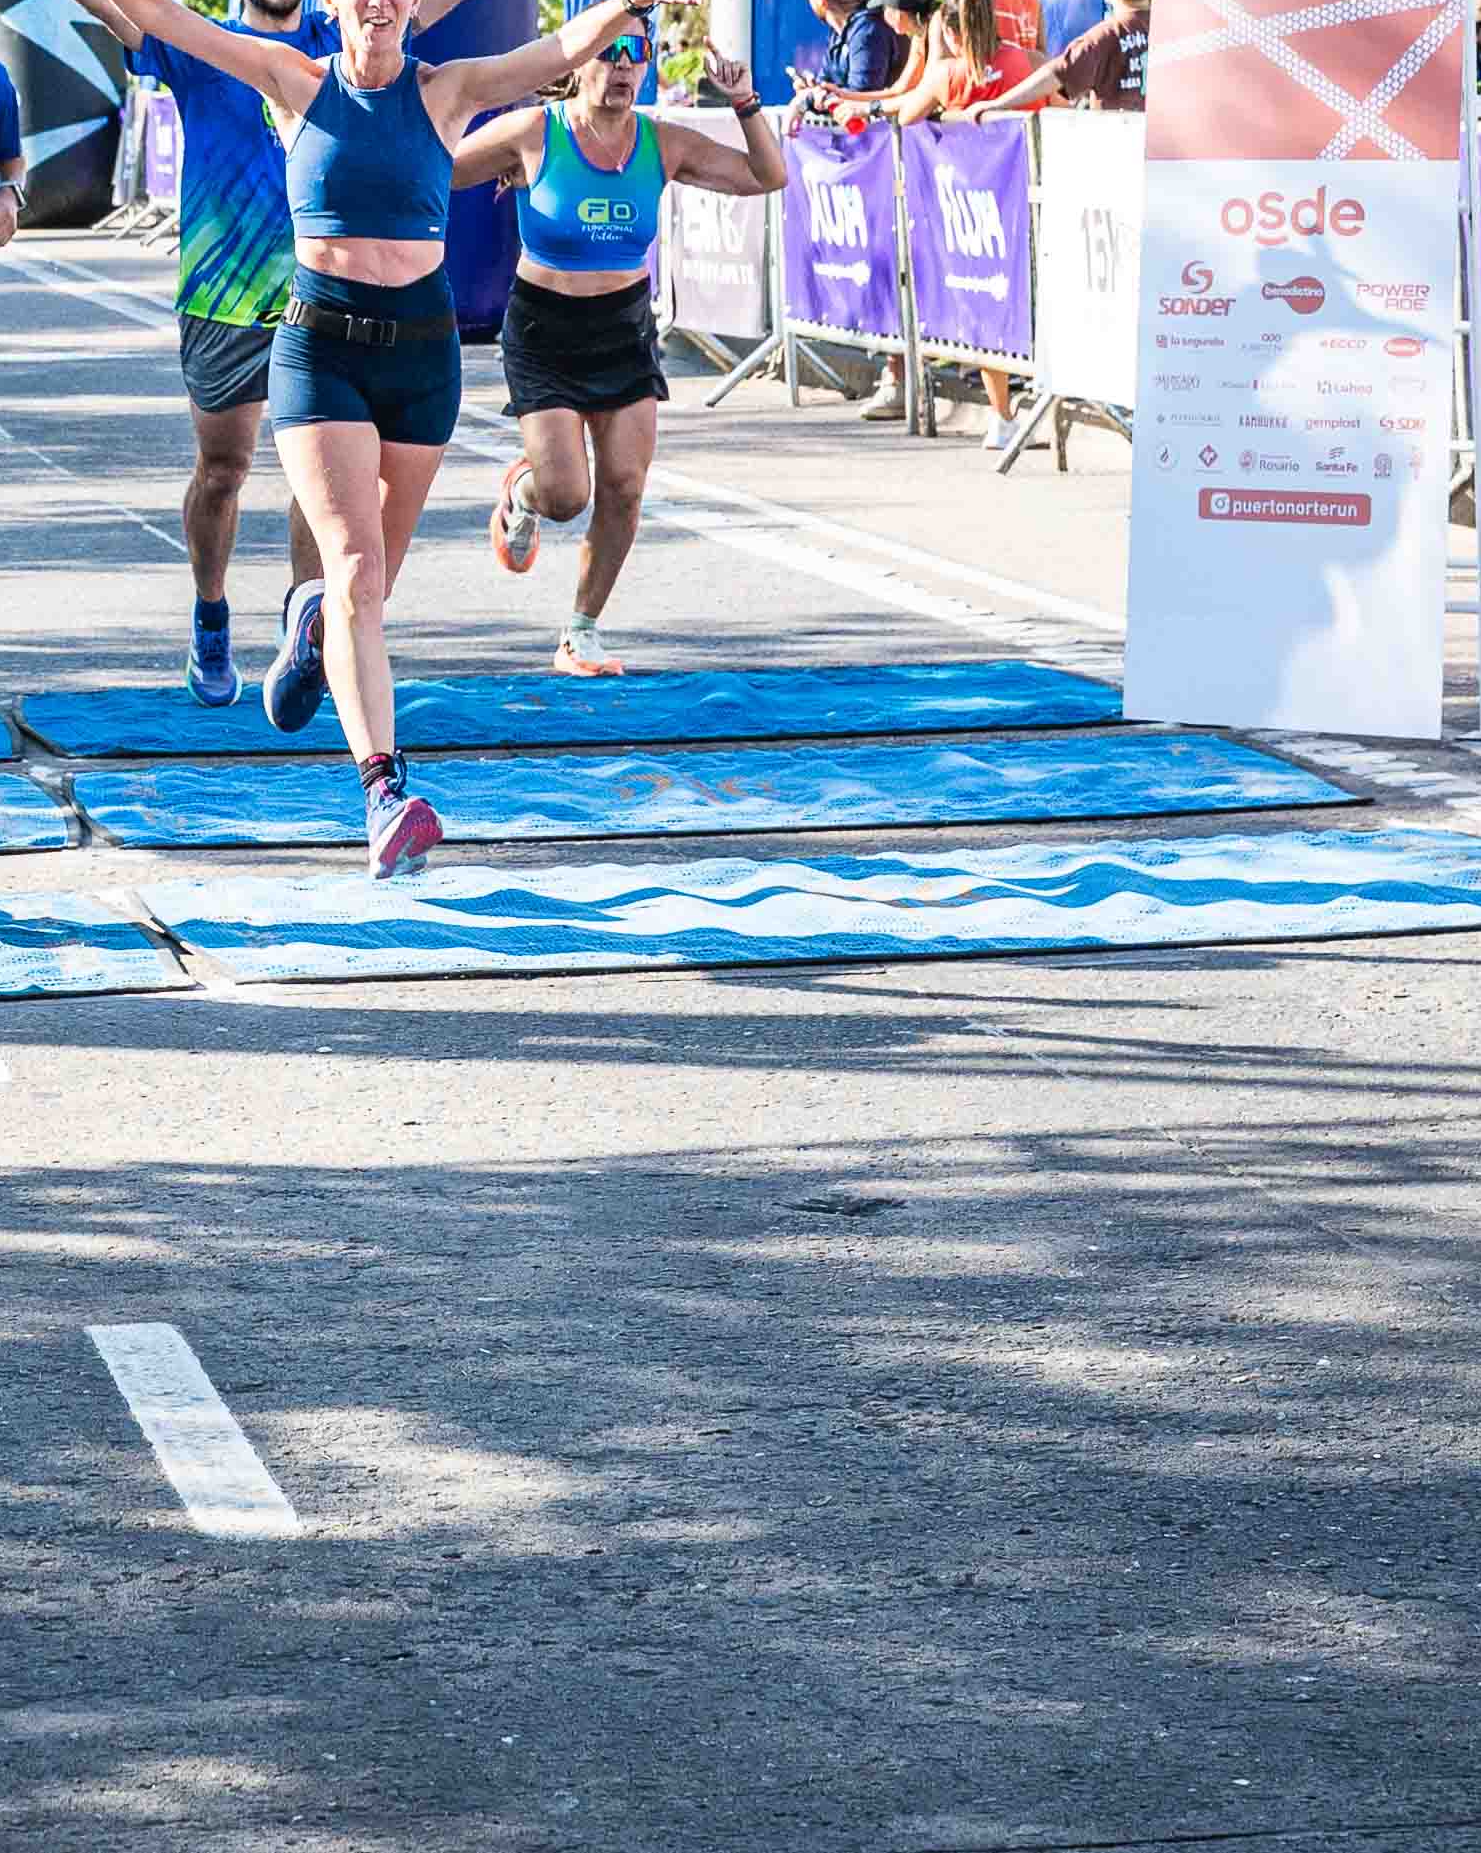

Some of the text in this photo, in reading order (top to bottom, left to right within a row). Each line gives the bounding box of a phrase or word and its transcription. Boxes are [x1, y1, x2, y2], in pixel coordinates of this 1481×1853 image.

[1220, 183, 1366, 245] osde
[1356, 283, 1430, 297] POWER
[1259, 458, 1301, 472] Rosario
[1232, 499, 1358, 518] puertonorterun
